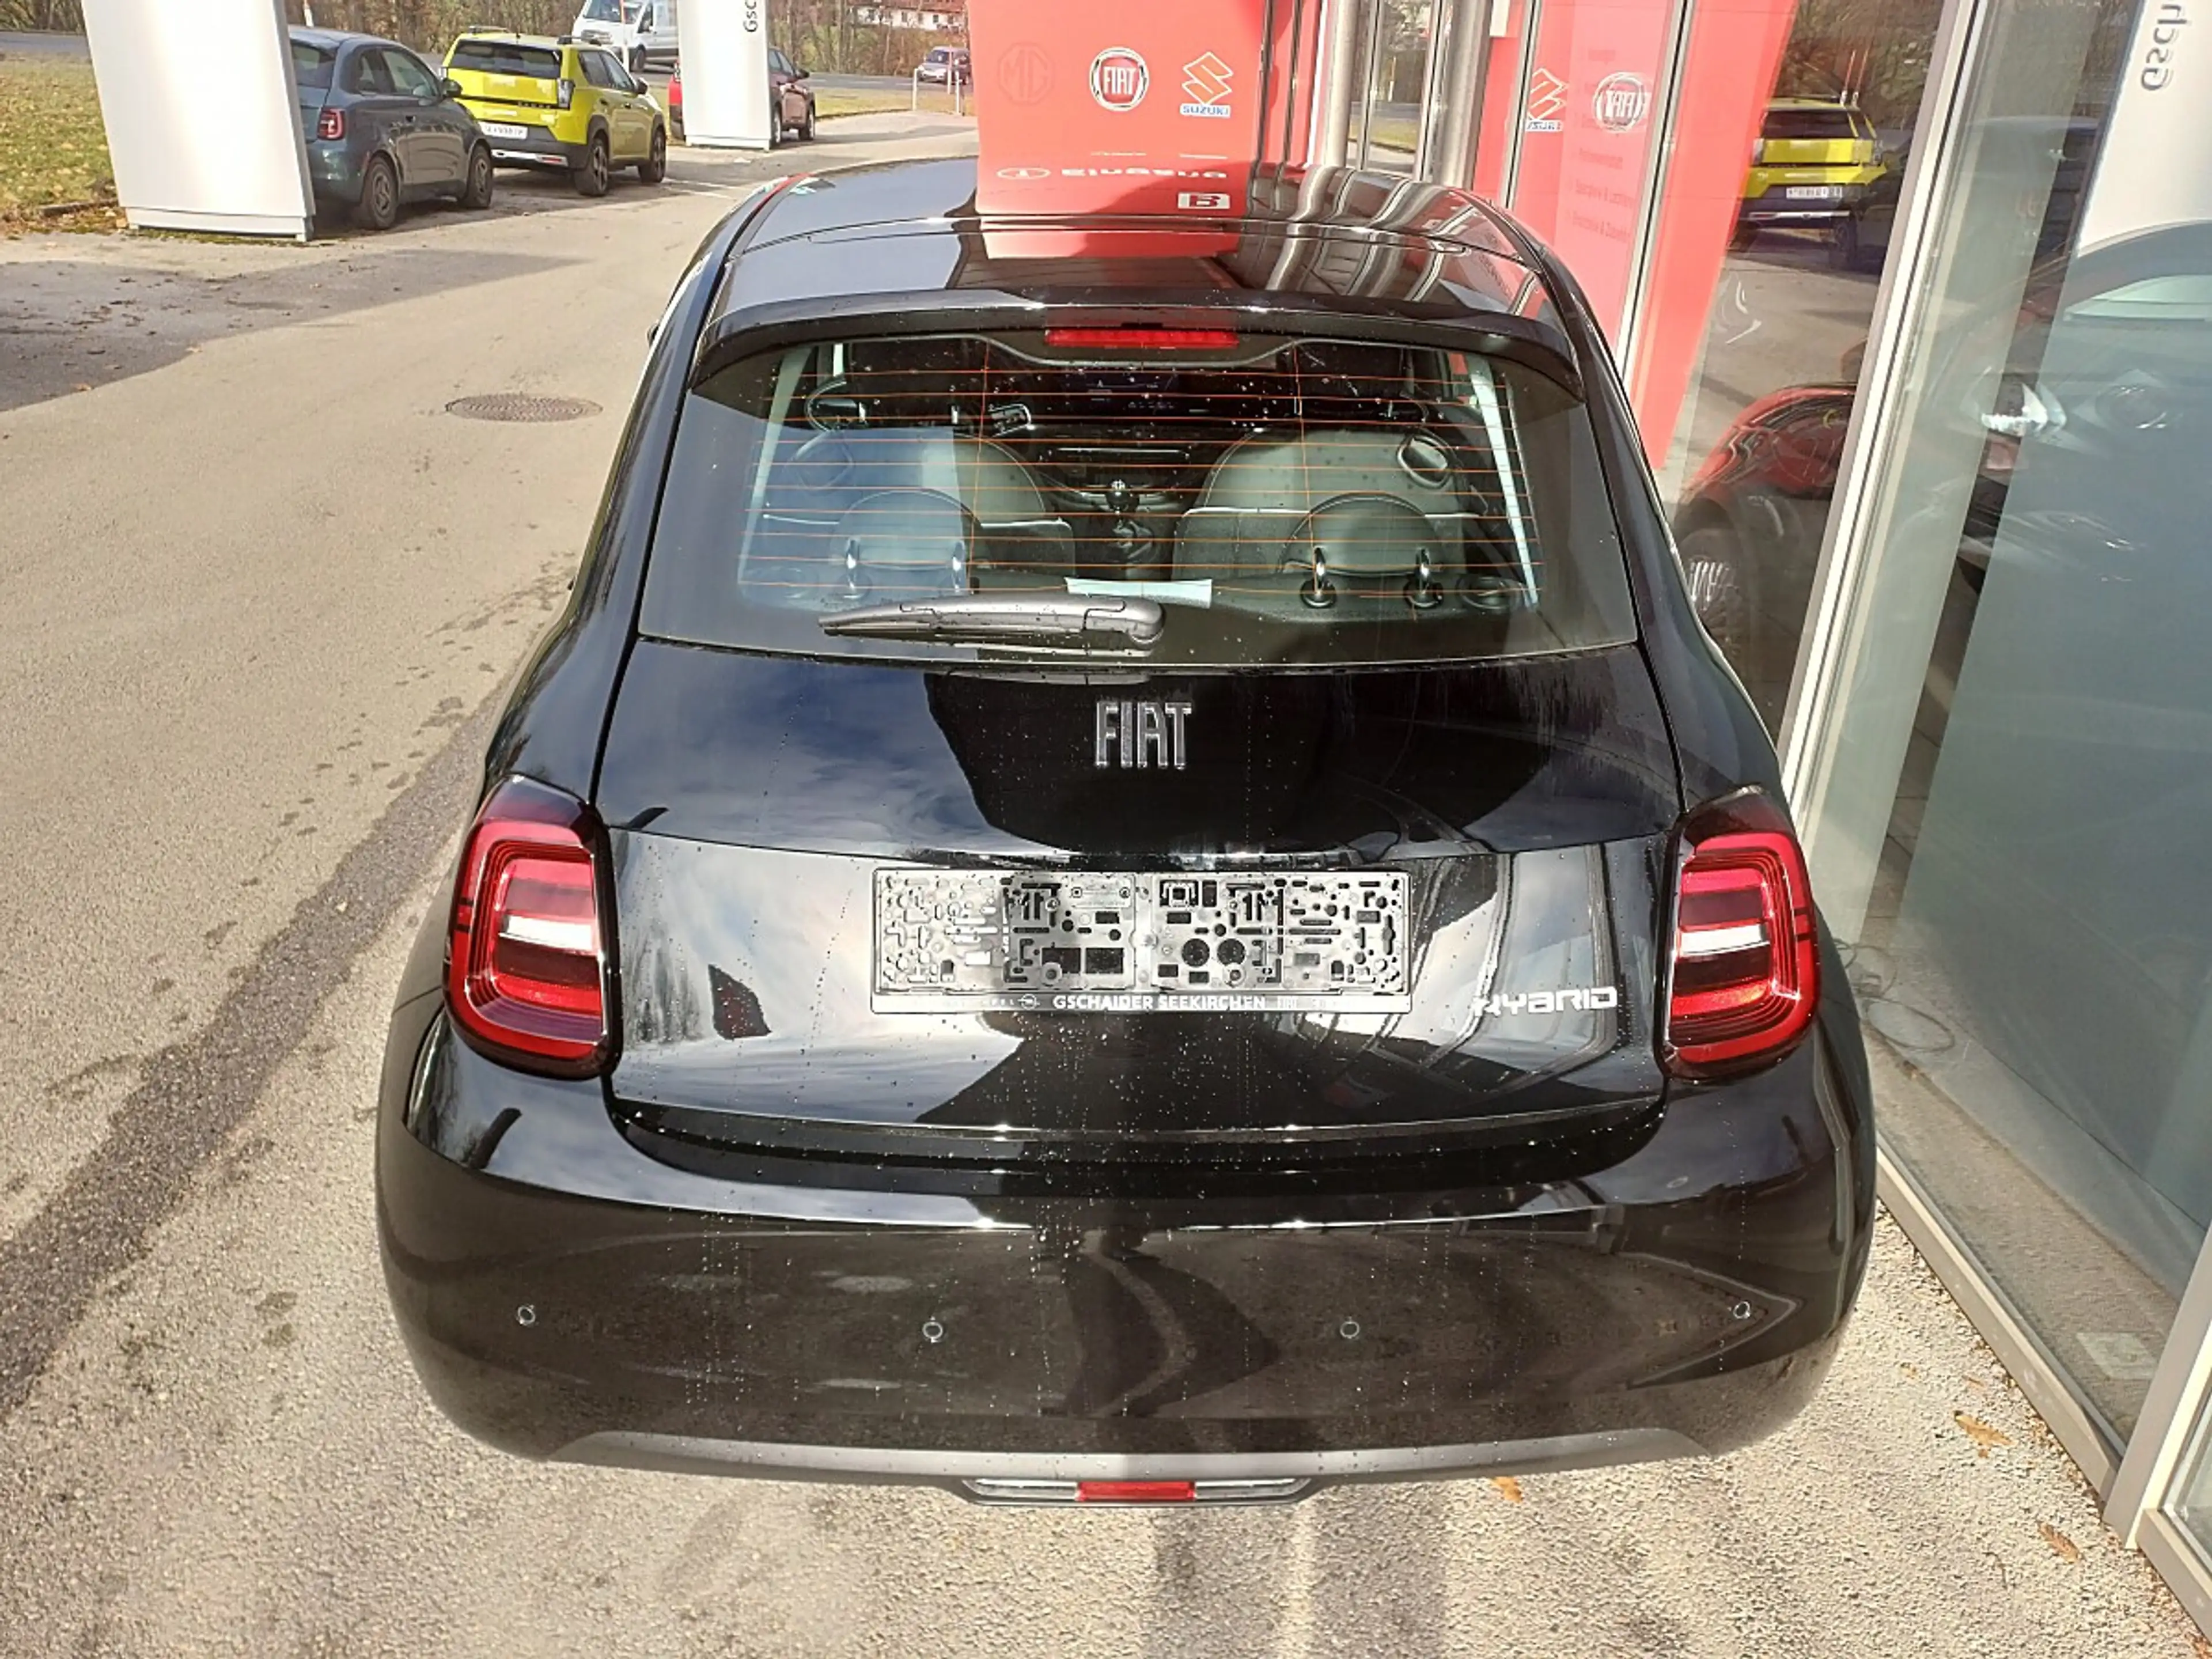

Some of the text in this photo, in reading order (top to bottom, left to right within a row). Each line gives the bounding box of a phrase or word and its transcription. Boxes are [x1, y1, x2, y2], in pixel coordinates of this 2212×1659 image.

[1002, 47, 1050, 100] MG
[1103, 66, 1137, 96] FIAT
[1182, 105, 1229, 116] SUZUKI
[1096, 702, 1192, 770] FIAT
[1052, 994, 1153, 1009] GSCHAIDER
[1158, 994, 1266, 1010] SEEKIRCHEN
[1472, 986, 1618, 1017] HYBRID
